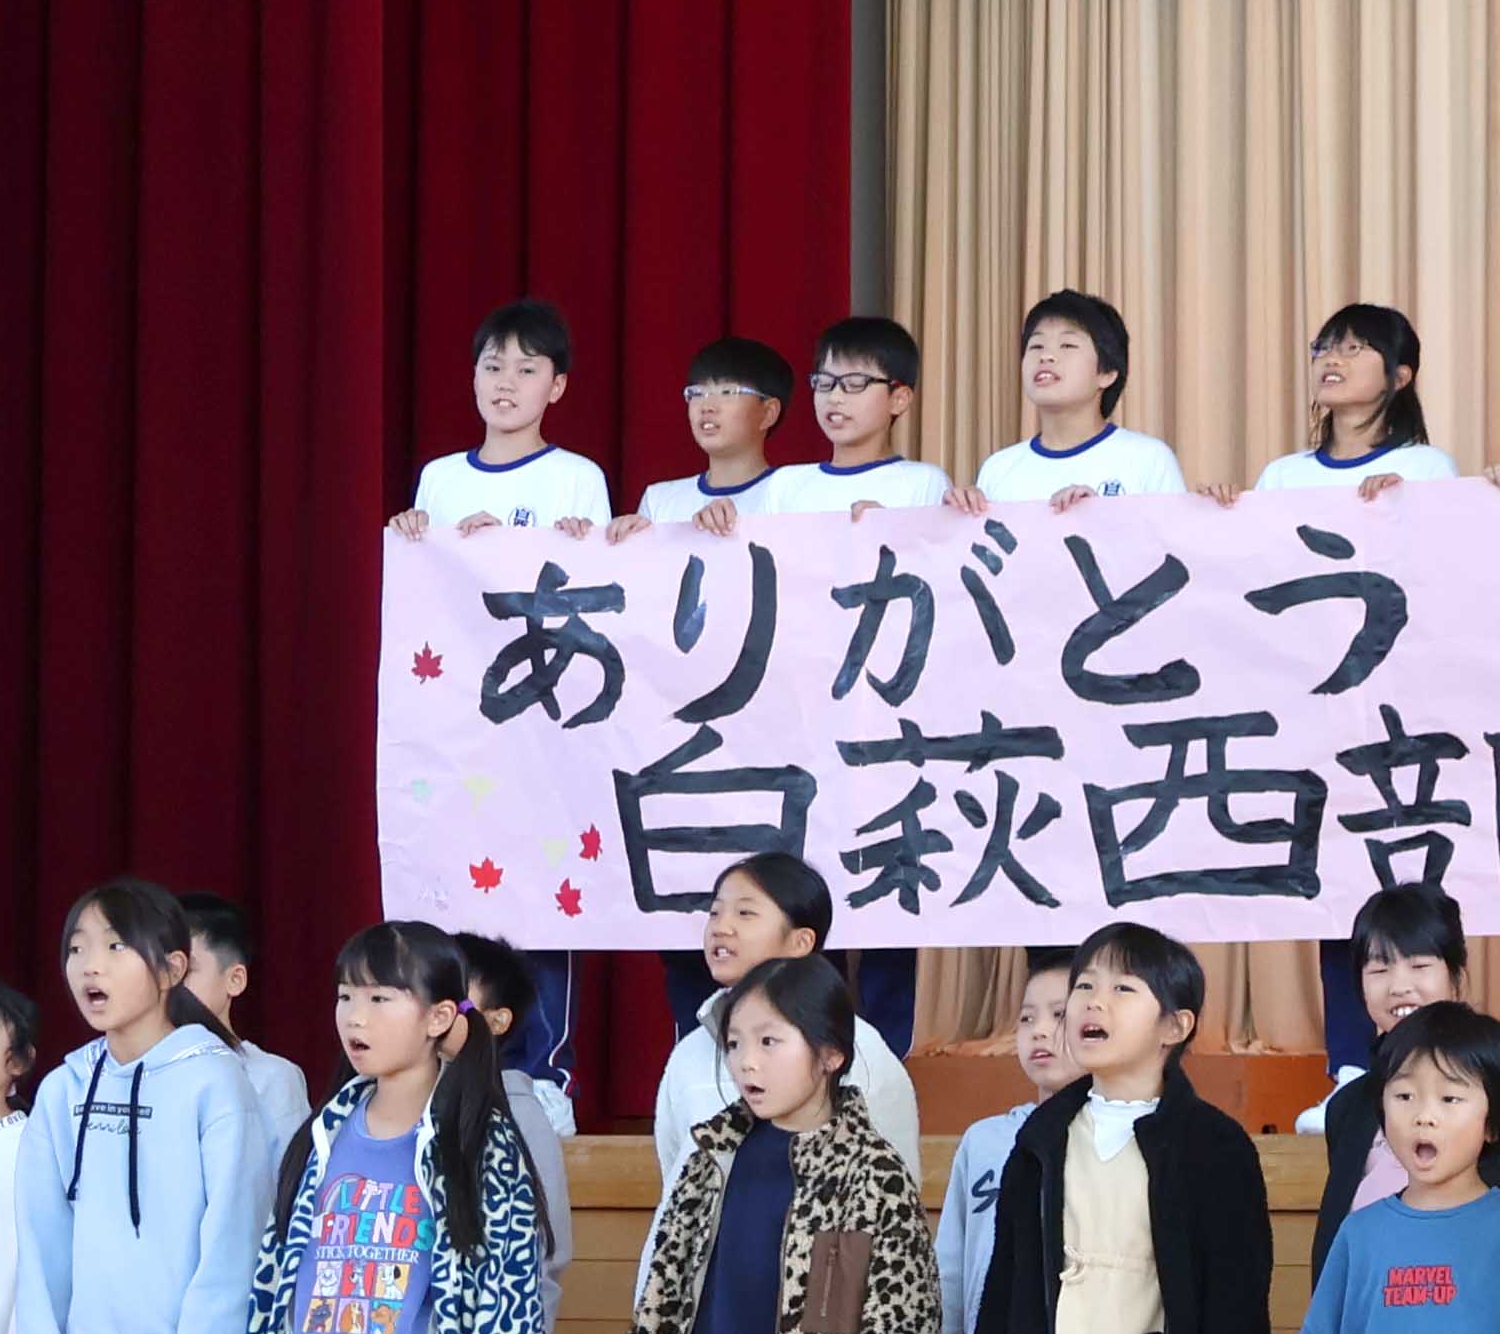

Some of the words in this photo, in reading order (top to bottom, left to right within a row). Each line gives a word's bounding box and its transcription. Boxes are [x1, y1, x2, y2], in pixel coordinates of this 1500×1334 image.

[479, 520, 1407, 728] ありがとう
[339, 1178, 421, 1214] LITTLE
[320, 1211, 437, 1251] FRIENDS
[348, 1244, 419, 1264] TOGETHER
[1388, 1266, 1452, 1285] MARVEL
[1382, 1285, 1457, 1307] TEAM-UP
